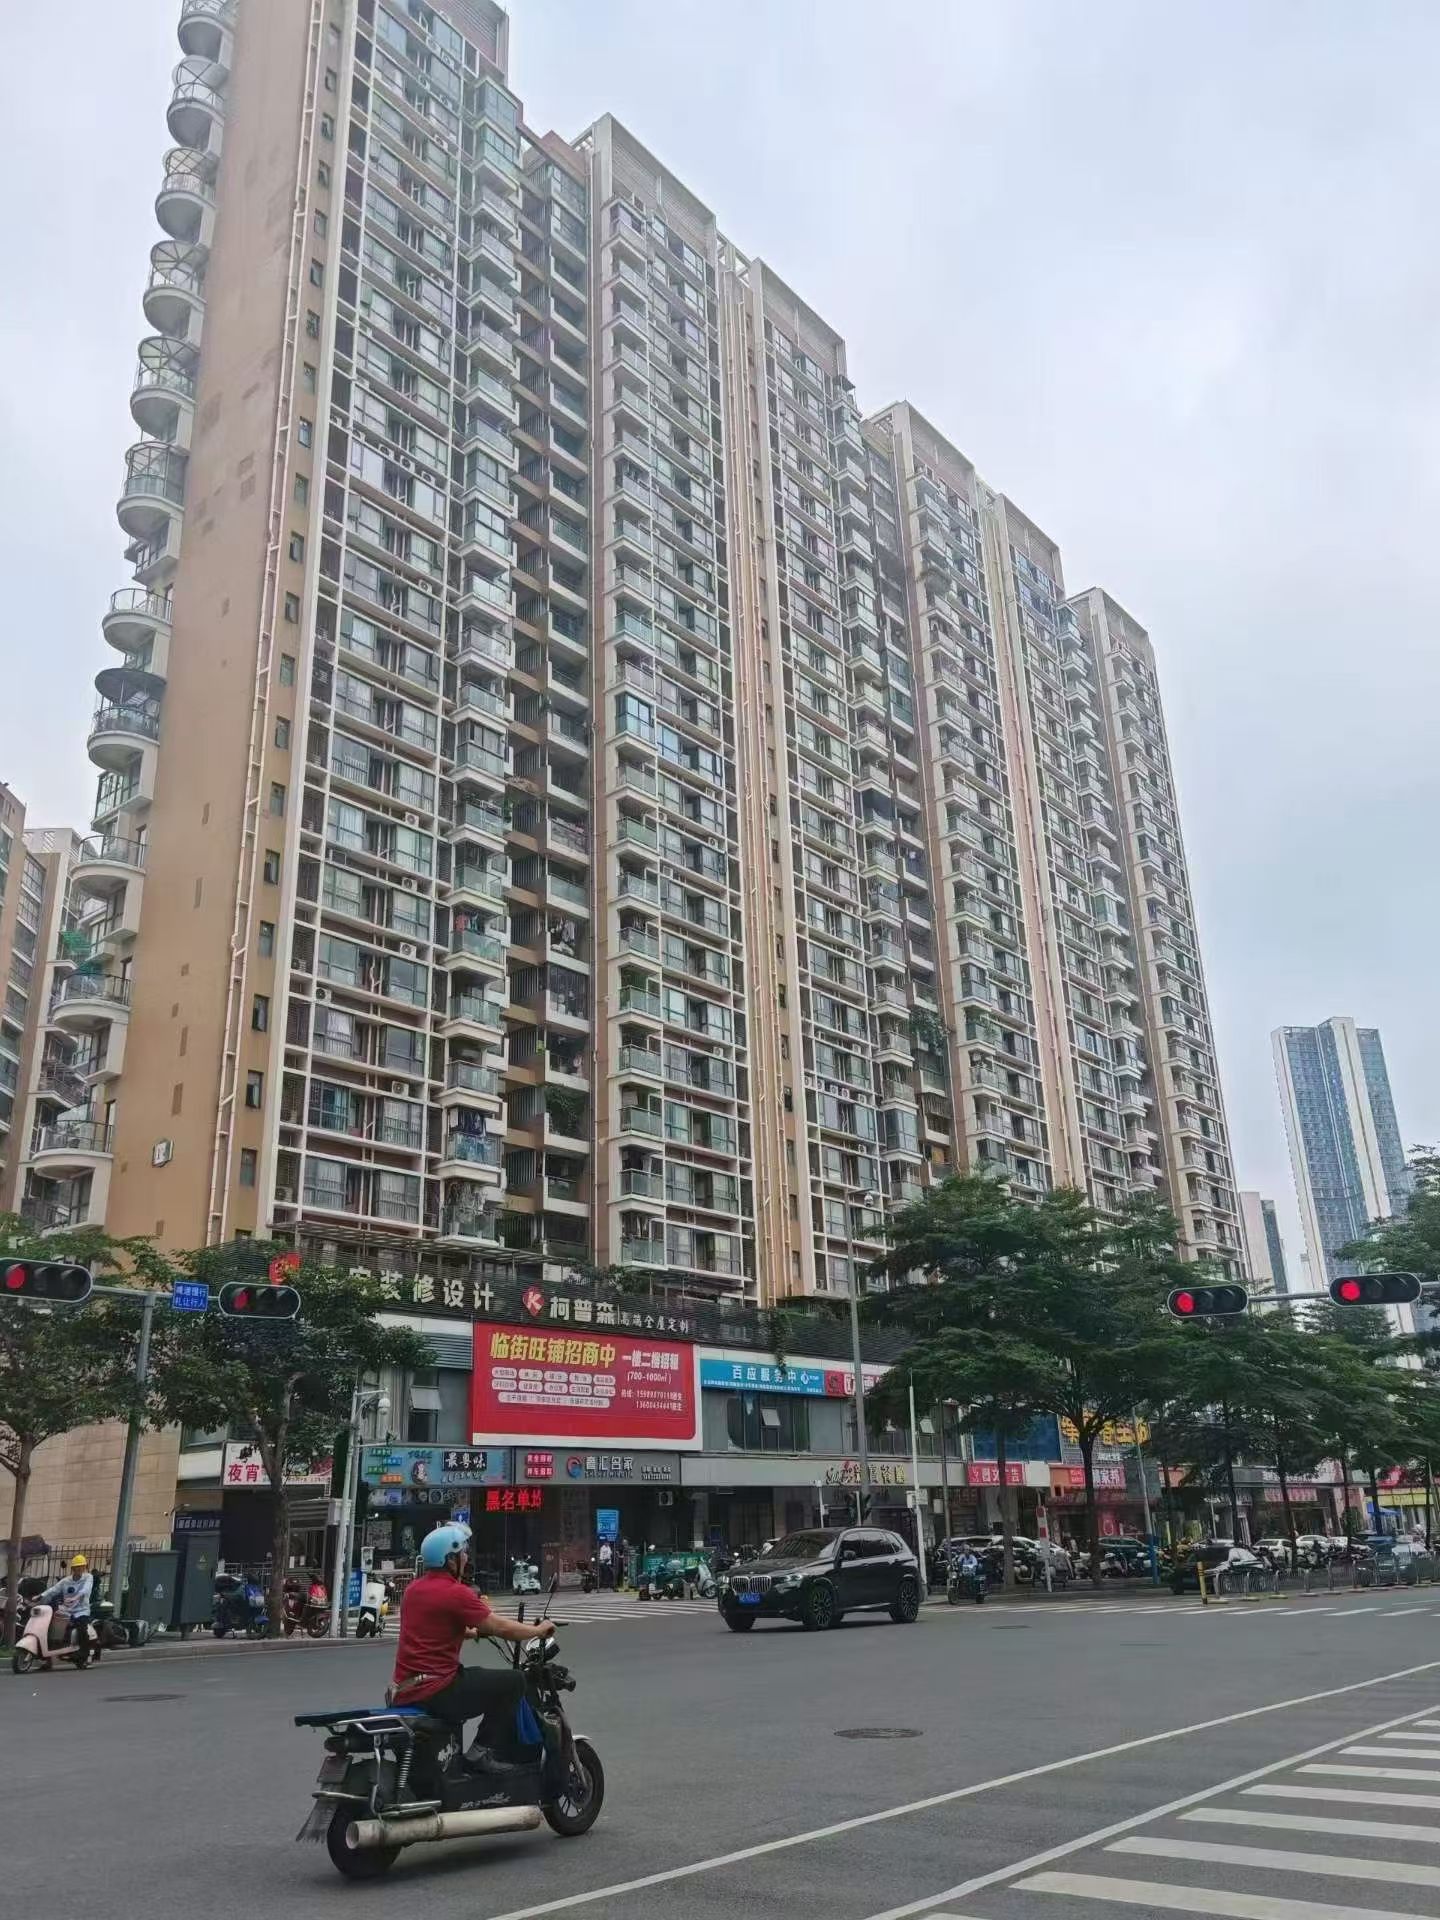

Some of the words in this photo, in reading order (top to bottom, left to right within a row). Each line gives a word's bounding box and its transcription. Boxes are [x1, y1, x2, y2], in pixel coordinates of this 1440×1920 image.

[490, 1332, 616, 1368] 临街旺铺招商中
[622, 1350, 679, 1370] 一楼二楼招租
[228, 1464, 259, 1482] 夜宵
